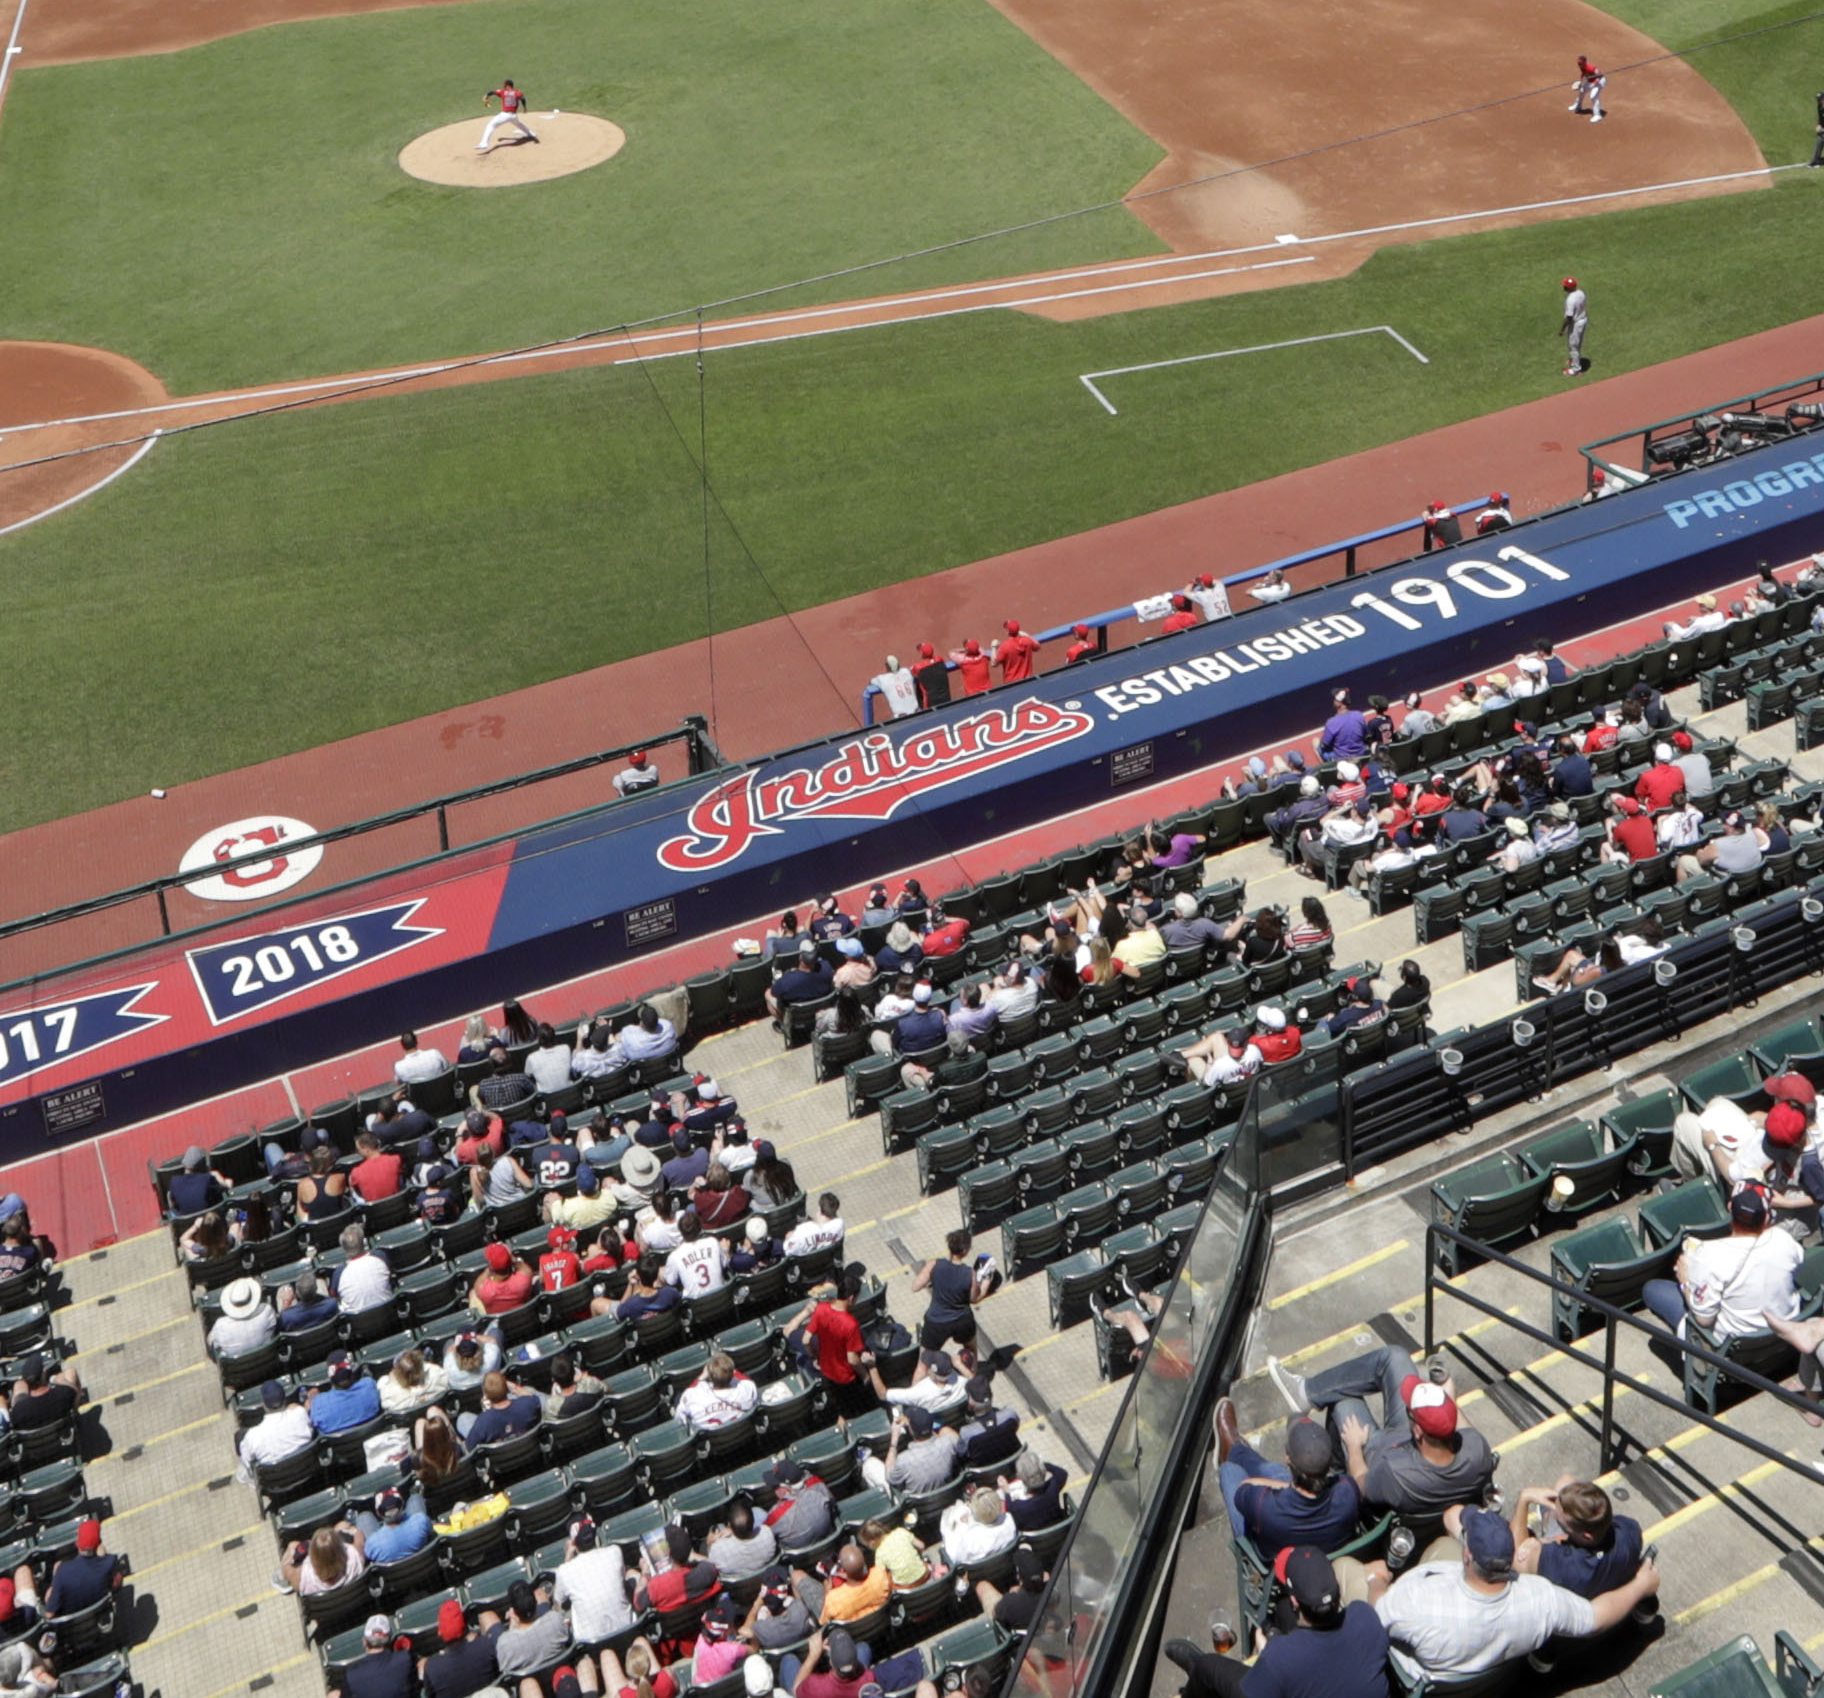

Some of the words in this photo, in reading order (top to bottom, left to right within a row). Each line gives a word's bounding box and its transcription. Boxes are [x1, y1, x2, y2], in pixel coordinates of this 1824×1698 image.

[656, 696, 1094, 872] Indians
[1106, 607, 1366, 715] ESTABLISHED
[1351, 545, 1571, 633] 1901
[221, 923, 361, 997] 2018
[64, 1085, 97, 1104] ALERT
[539, 1161, 571, 1185] 22
[683, 1246, 713, 1269] ADLER
[550, 1271, 562, 1291] 7
[695, 1263, 710, 1288] 3
